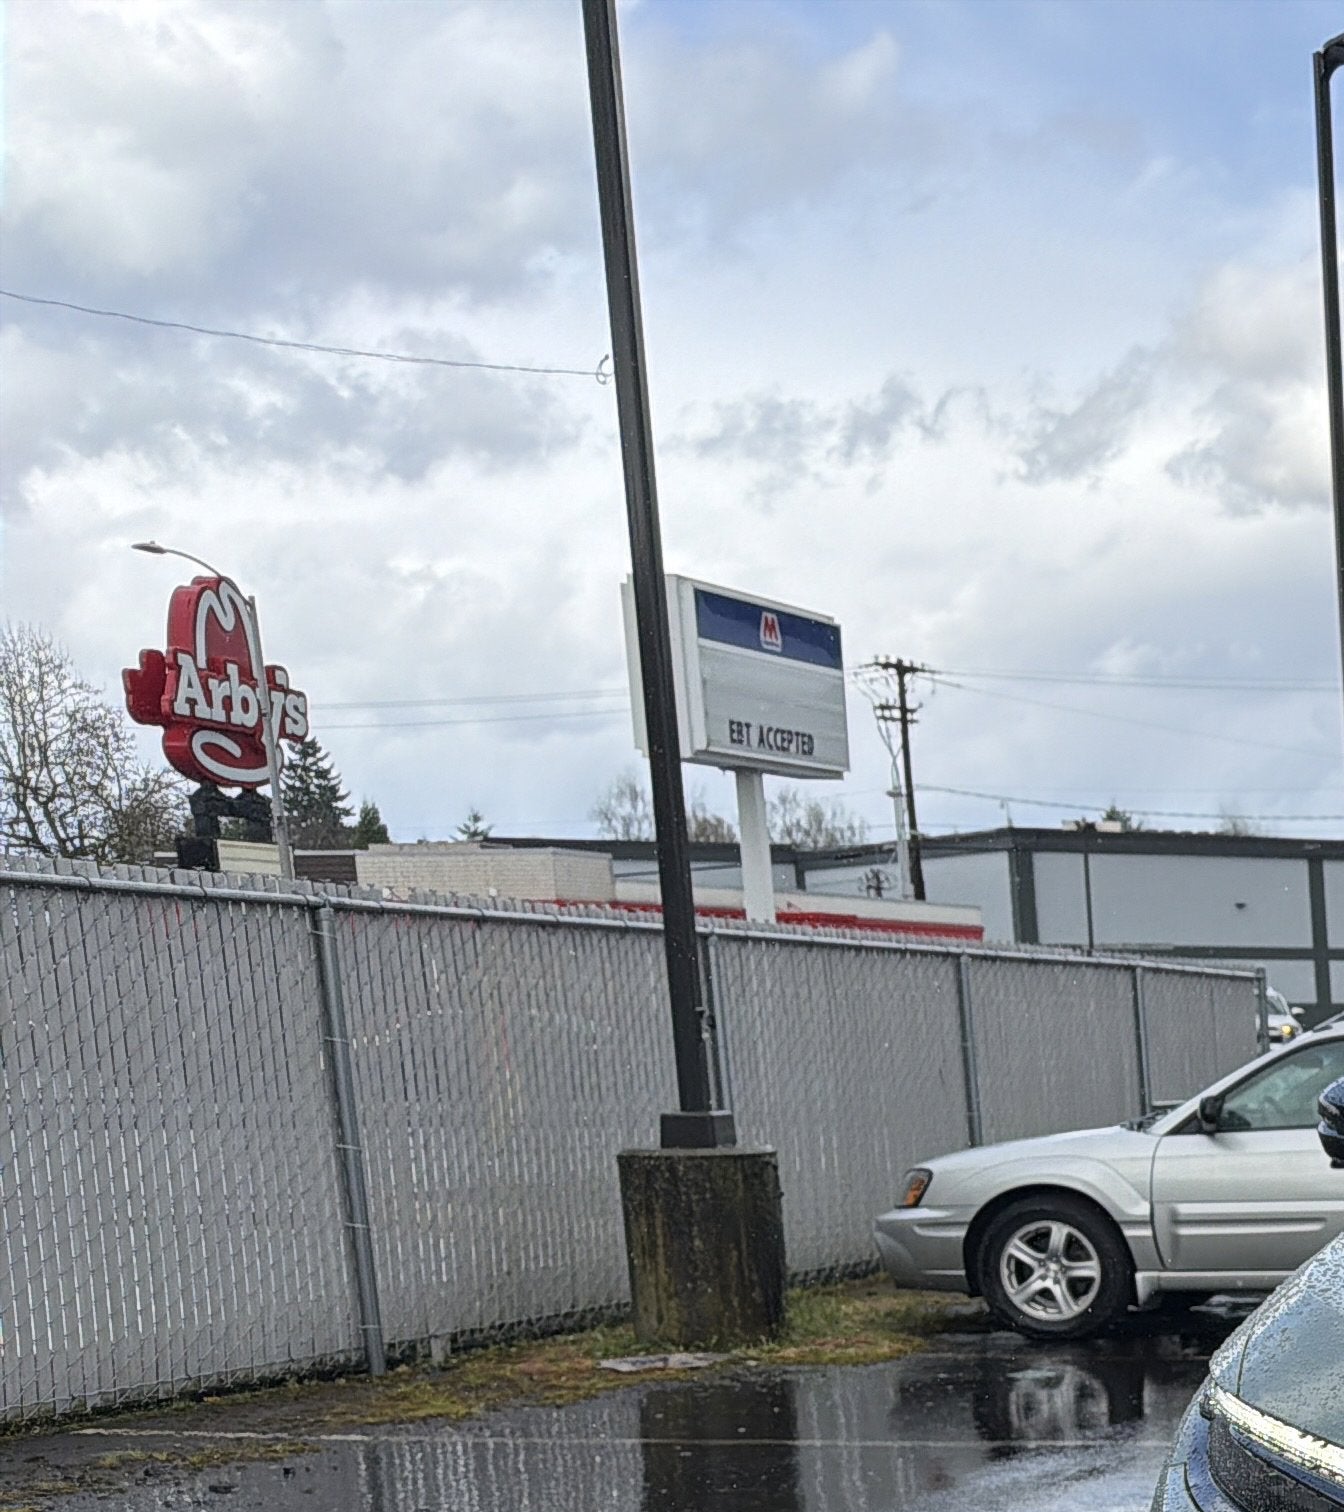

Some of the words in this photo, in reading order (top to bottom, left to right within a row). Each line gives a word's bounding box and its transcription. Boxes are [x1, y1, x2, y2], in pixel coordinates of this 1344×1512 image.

[173, 652, 307, 747] Arby's
[729, 719, 752, 747] EBT
[758, 724, 814, 755] ACCEPTED
